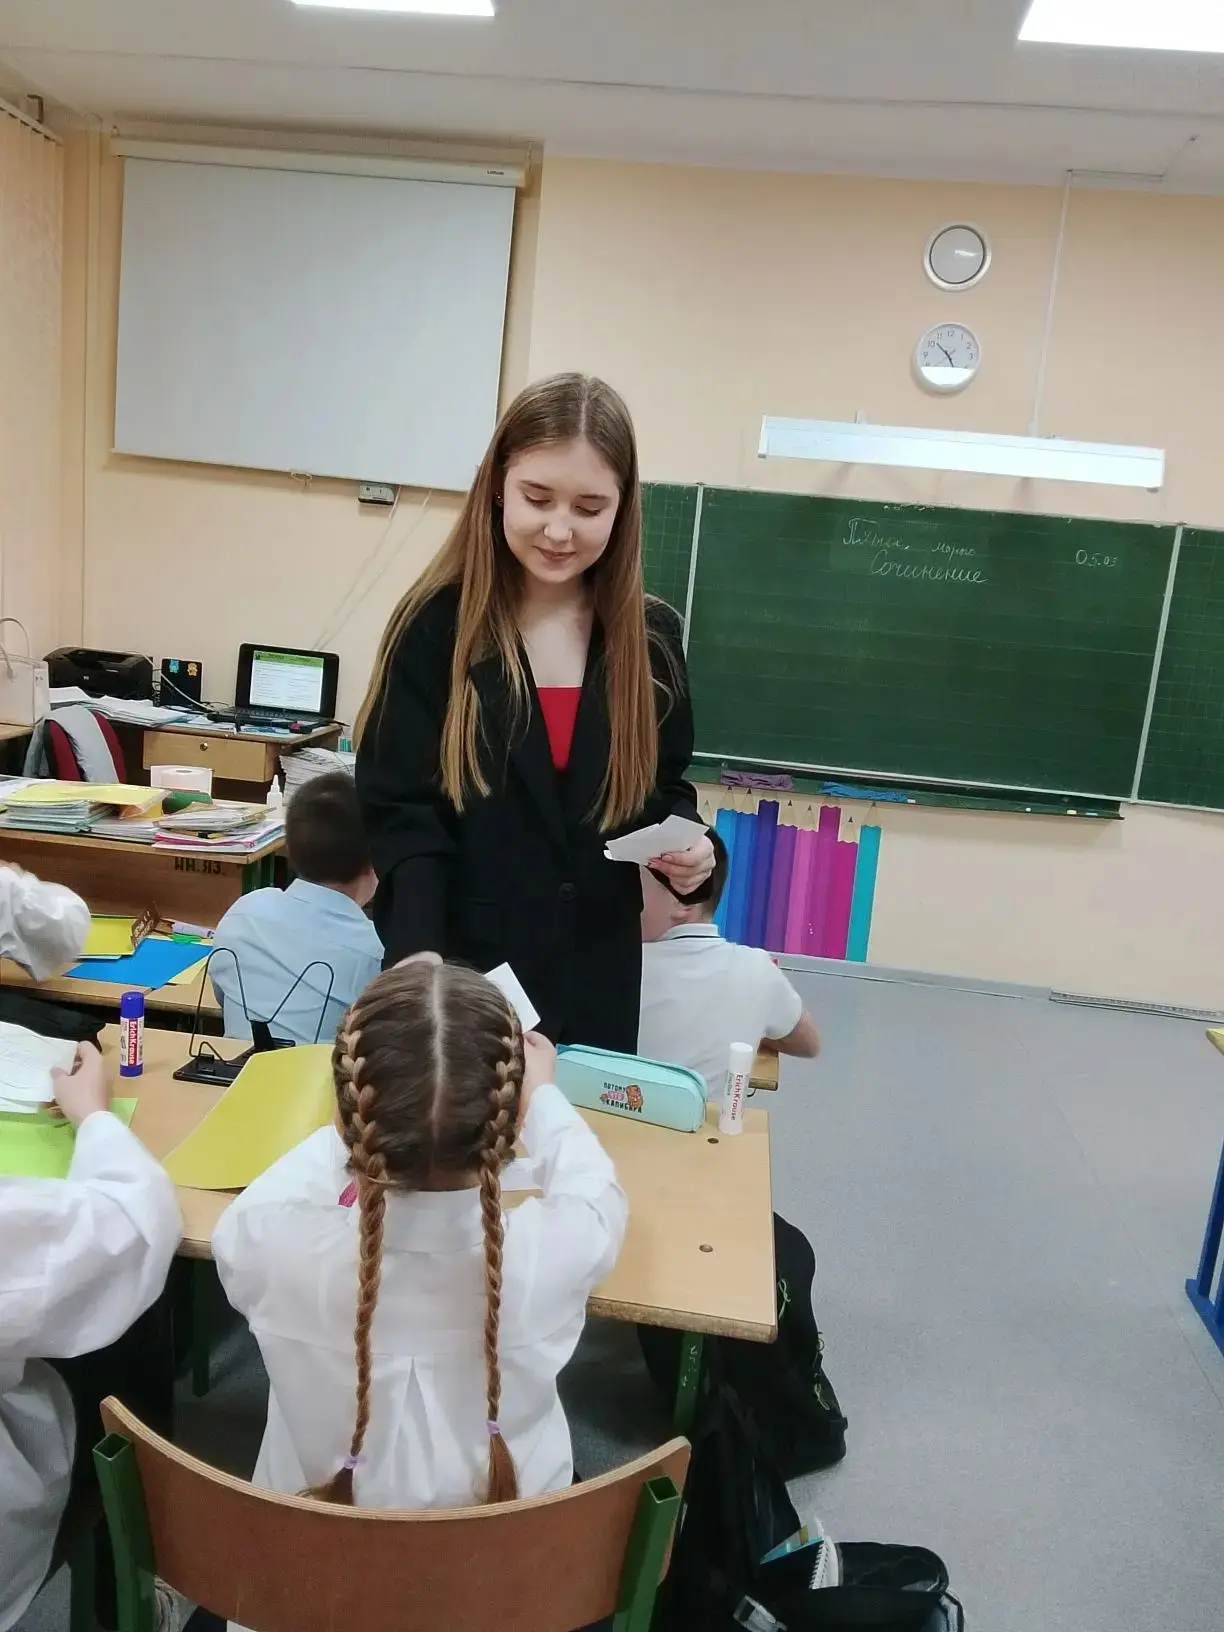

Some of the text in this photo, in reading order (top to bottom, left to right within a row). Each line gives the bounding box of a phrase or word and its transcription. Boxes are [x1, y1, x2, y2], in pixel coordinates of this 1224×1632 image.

[871, 549, 988, 583] Сочинение
[128, 1021, 137, 1065] ErichKrause
[731, 1074, 743, 1120] ErichKrause
